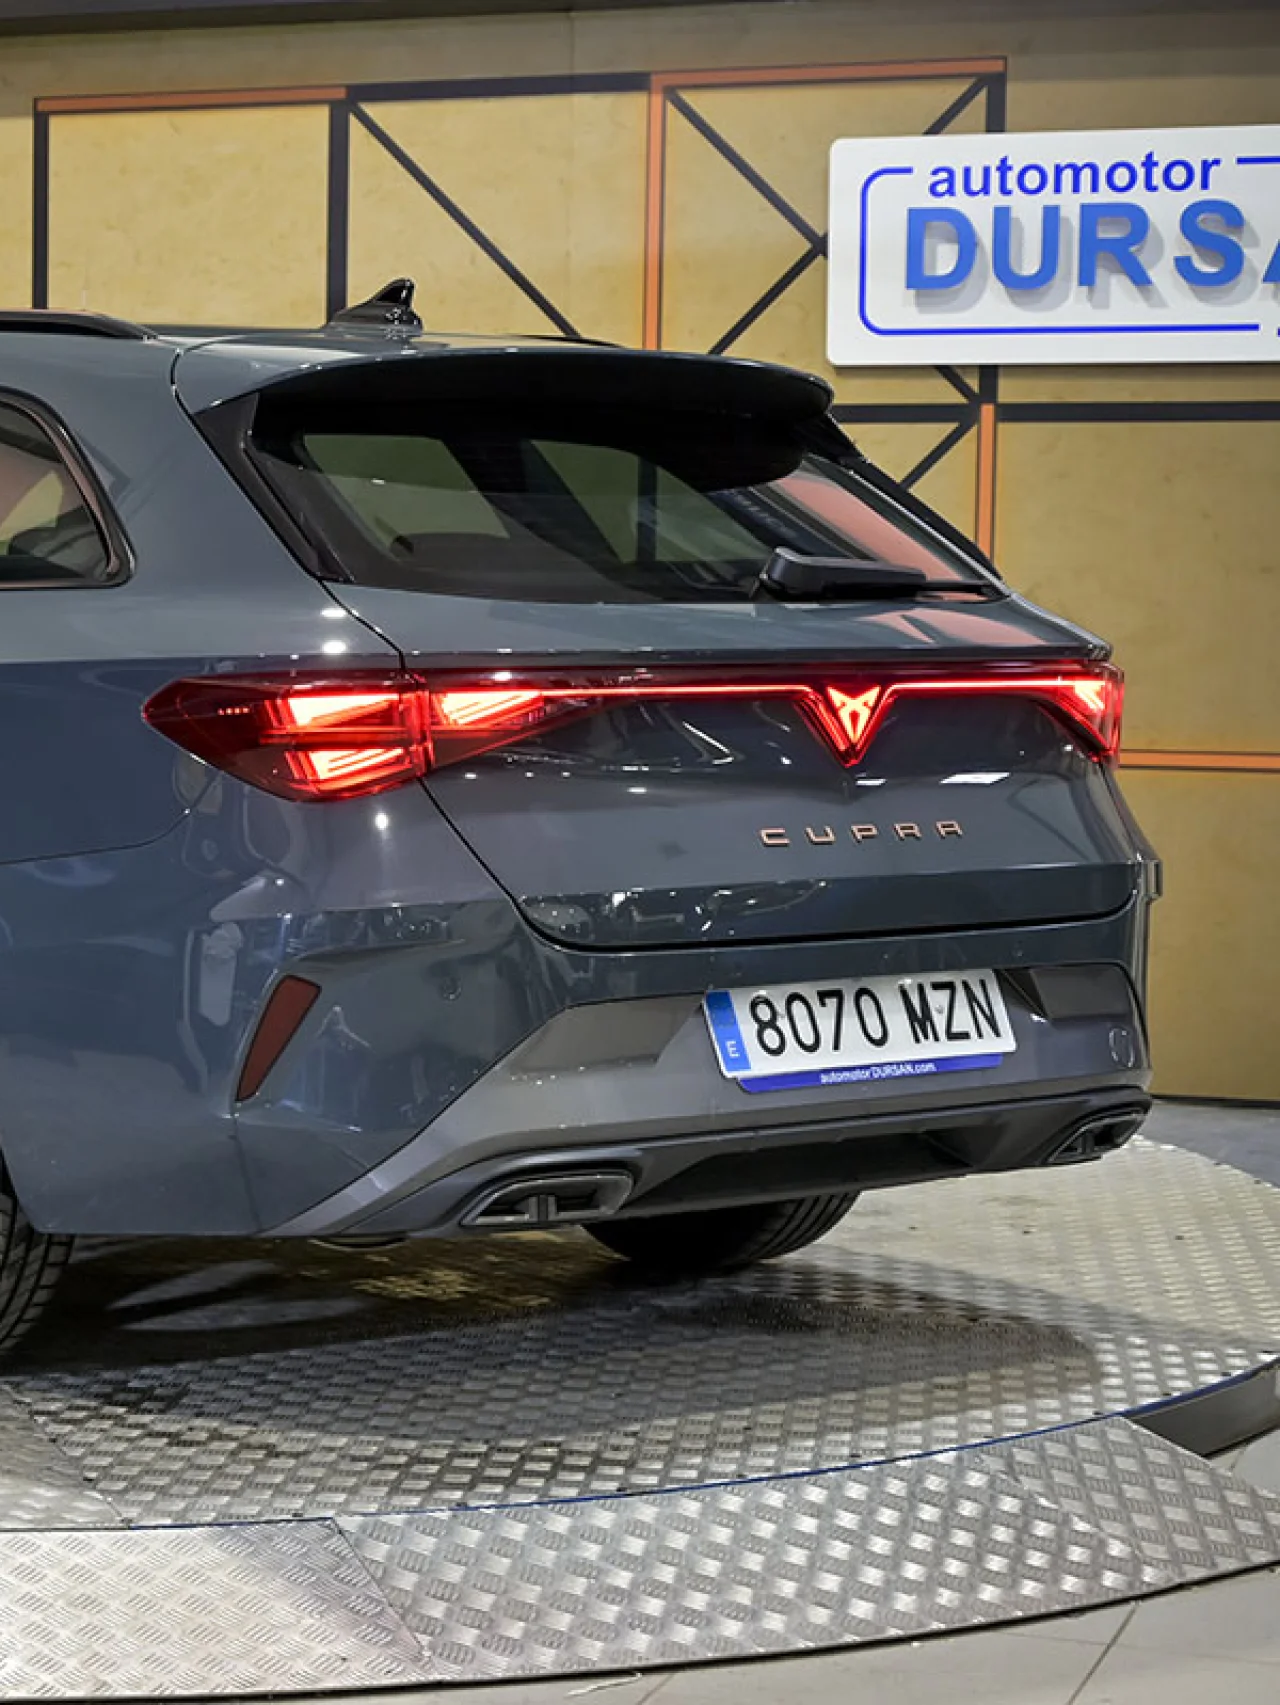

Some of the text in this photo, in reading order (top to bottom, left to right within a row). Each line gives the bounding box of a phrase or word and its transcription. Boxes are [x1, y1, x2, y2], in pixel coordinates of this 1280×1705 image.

[928, 151, 1222, 198] automotor
[906, 199, 1280, 290] DURS
[759, 820, 963, 847] CUPRA
[749, 978, 1003, 1057] 8070 MZN
[724, 1040, 740, 1058] E
